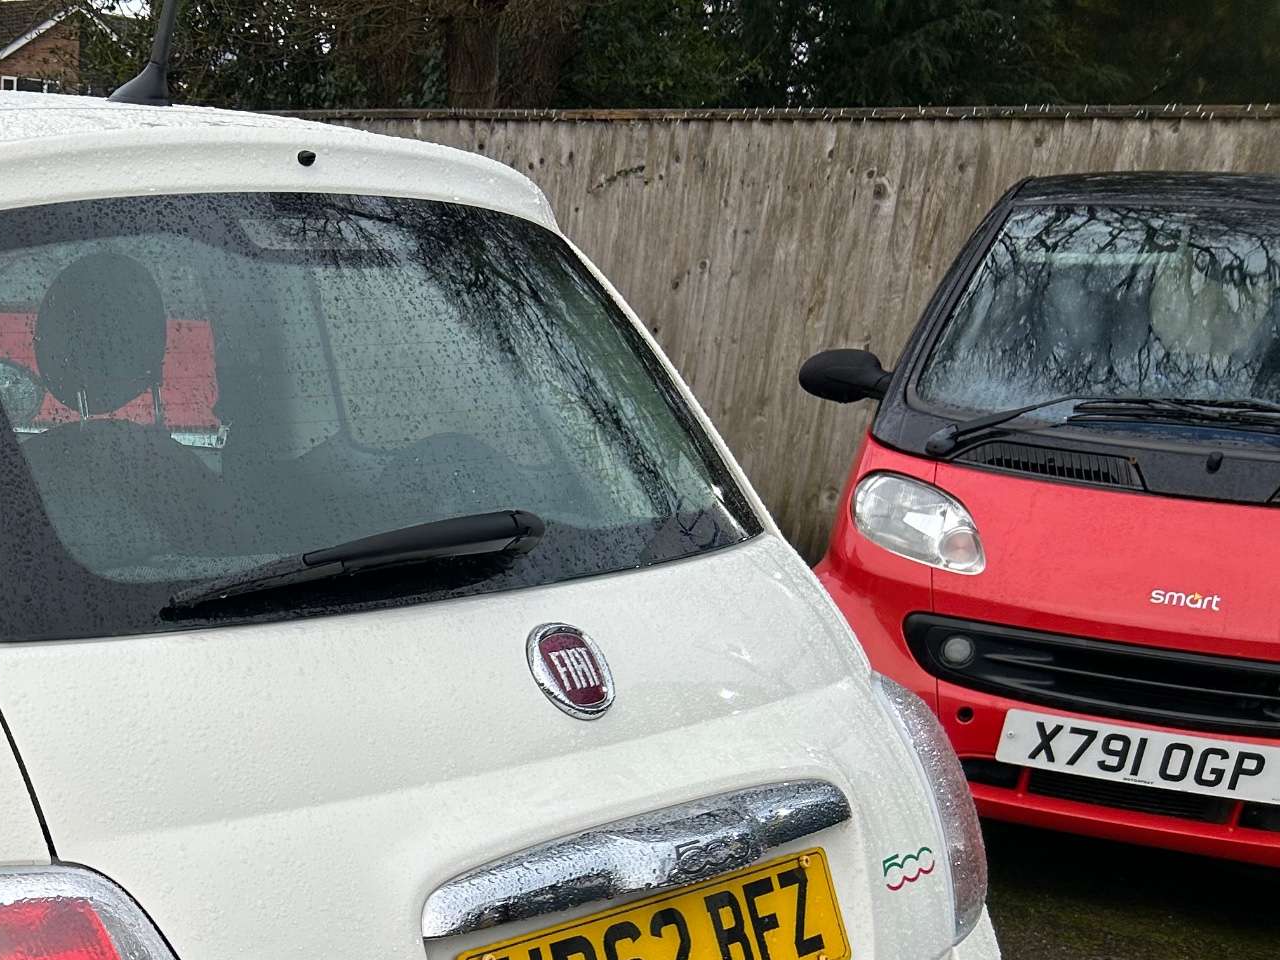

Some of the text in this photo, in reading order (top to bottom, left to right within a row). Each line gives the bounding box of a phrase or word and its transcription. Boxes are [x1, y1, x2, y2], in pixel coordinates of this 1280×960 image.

[1150, 589, 1221, 611] smart
[548, 647, 600, 691] FIAT
[1028, 721, 1266, 790] X791 OGP
[881, 846, 935, 891] 500
